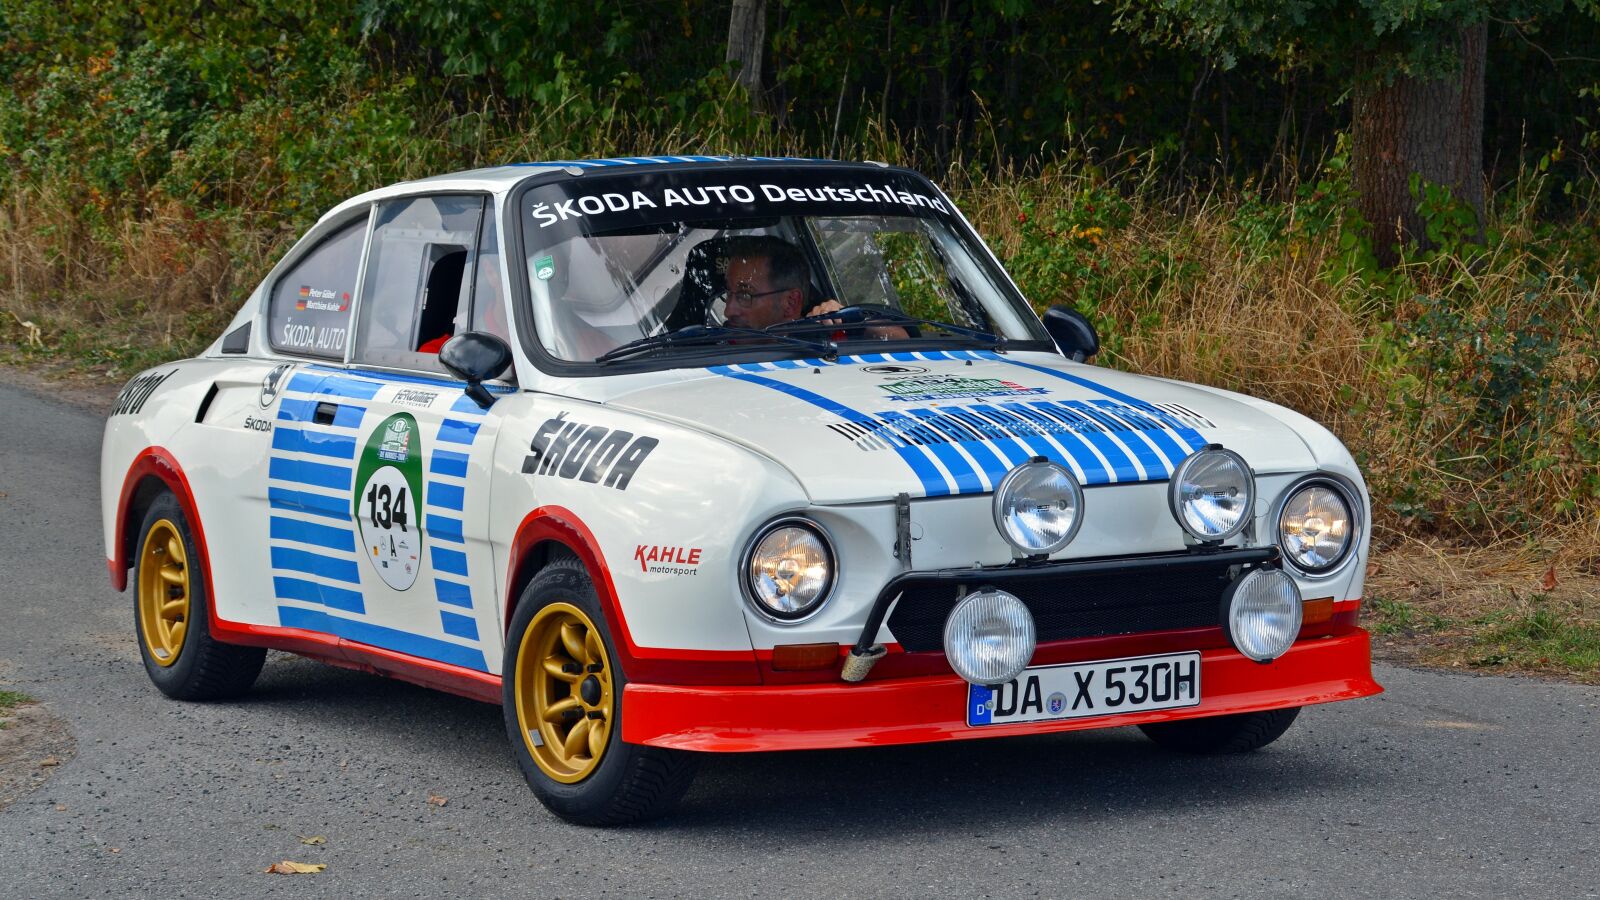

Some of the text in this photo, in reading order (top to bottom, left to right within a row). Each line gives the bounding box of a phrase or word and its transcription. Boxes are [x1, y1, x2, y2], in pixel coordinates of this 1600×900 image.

[532, 184, 950, 228] ŠKODA AUTO Deutschland
[306, 300, 327, 311] Matthias
[309, 288, 323, 298] Peter
[281, 317, 345, 351] ŠKODA AUTO
[243, 415, 272, 433] ŠKODA
[521, 411, 660, 491] ŠKODA
[367, 483, 408, 533] 134
[390, 534, 397, 557] A
[634, 544, 702, 573] KAHLE
[649, 566, 698, 576] motorsport
[992, 660, 1196, 717] DA X 530H
[976, 704, 985, 716] D
